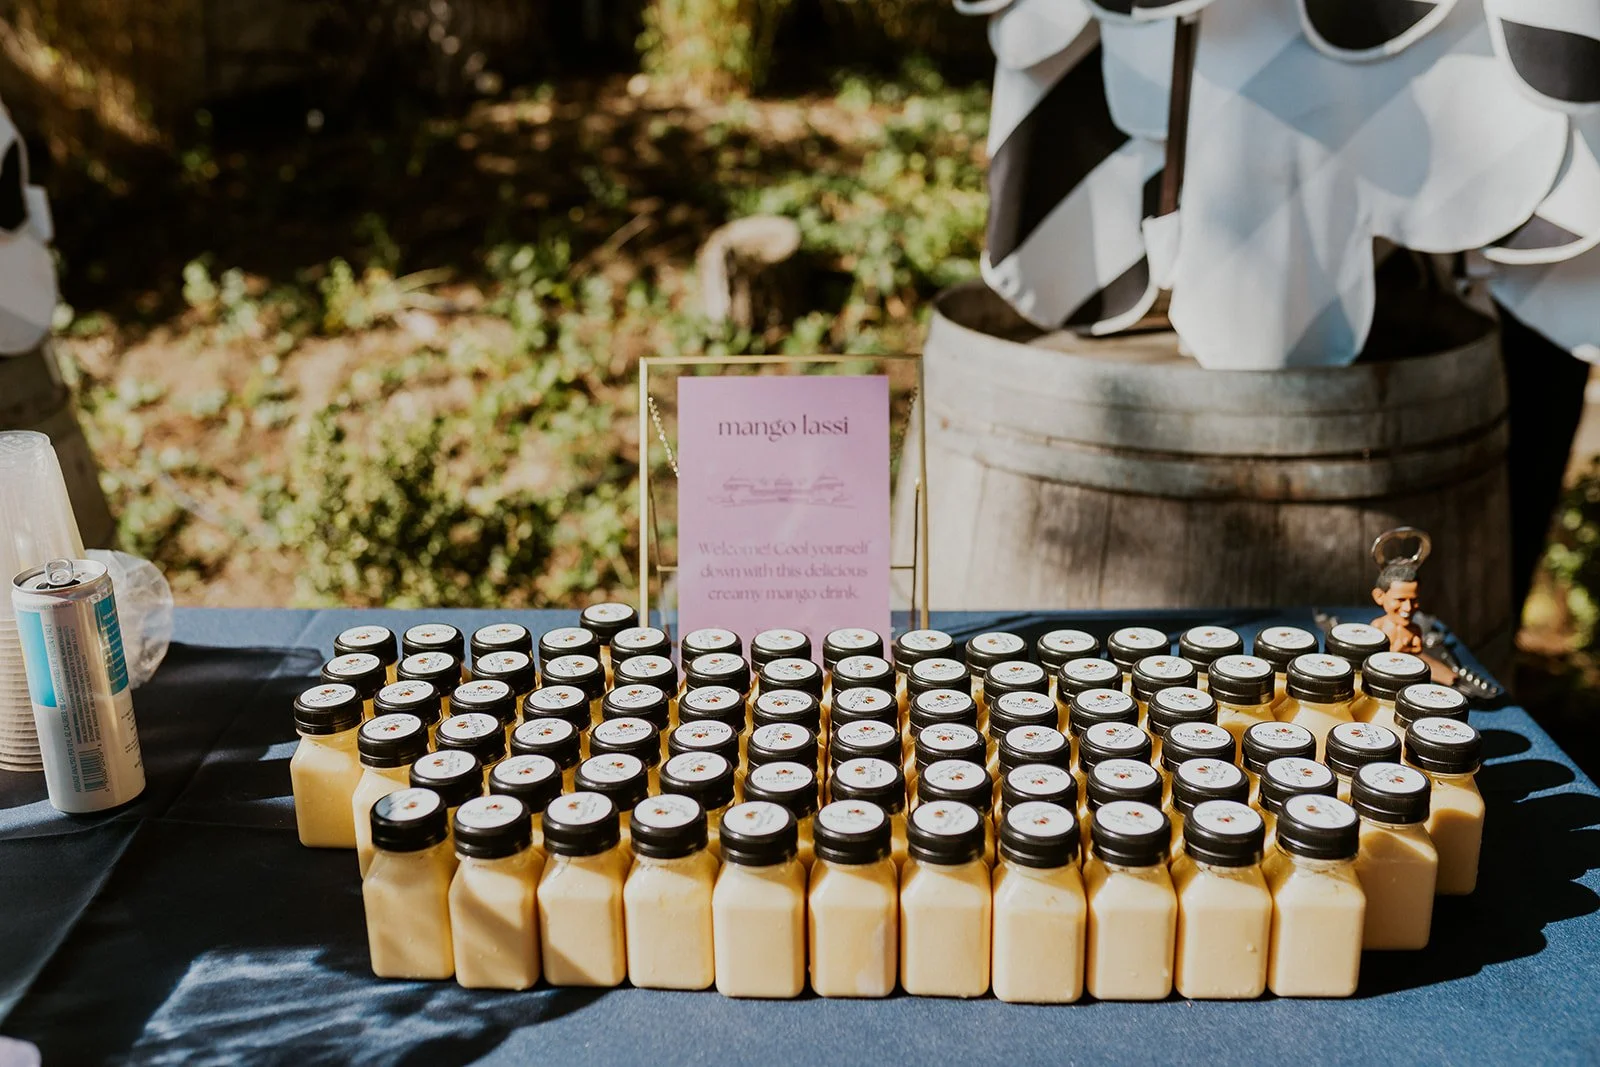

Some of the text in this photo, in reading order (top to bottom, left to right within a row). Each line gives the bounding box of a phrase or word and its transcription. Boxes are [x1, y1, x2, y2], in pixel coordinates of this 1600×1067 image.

[718, 413, 849, 442] mango lassi
[697, 539, 872, 558] Welcome! Cool yourself
[700, 563, 869, 578] down with this delicious
[707, 588, 760, 604] creamy
[766, 588, 818, 604] mango
